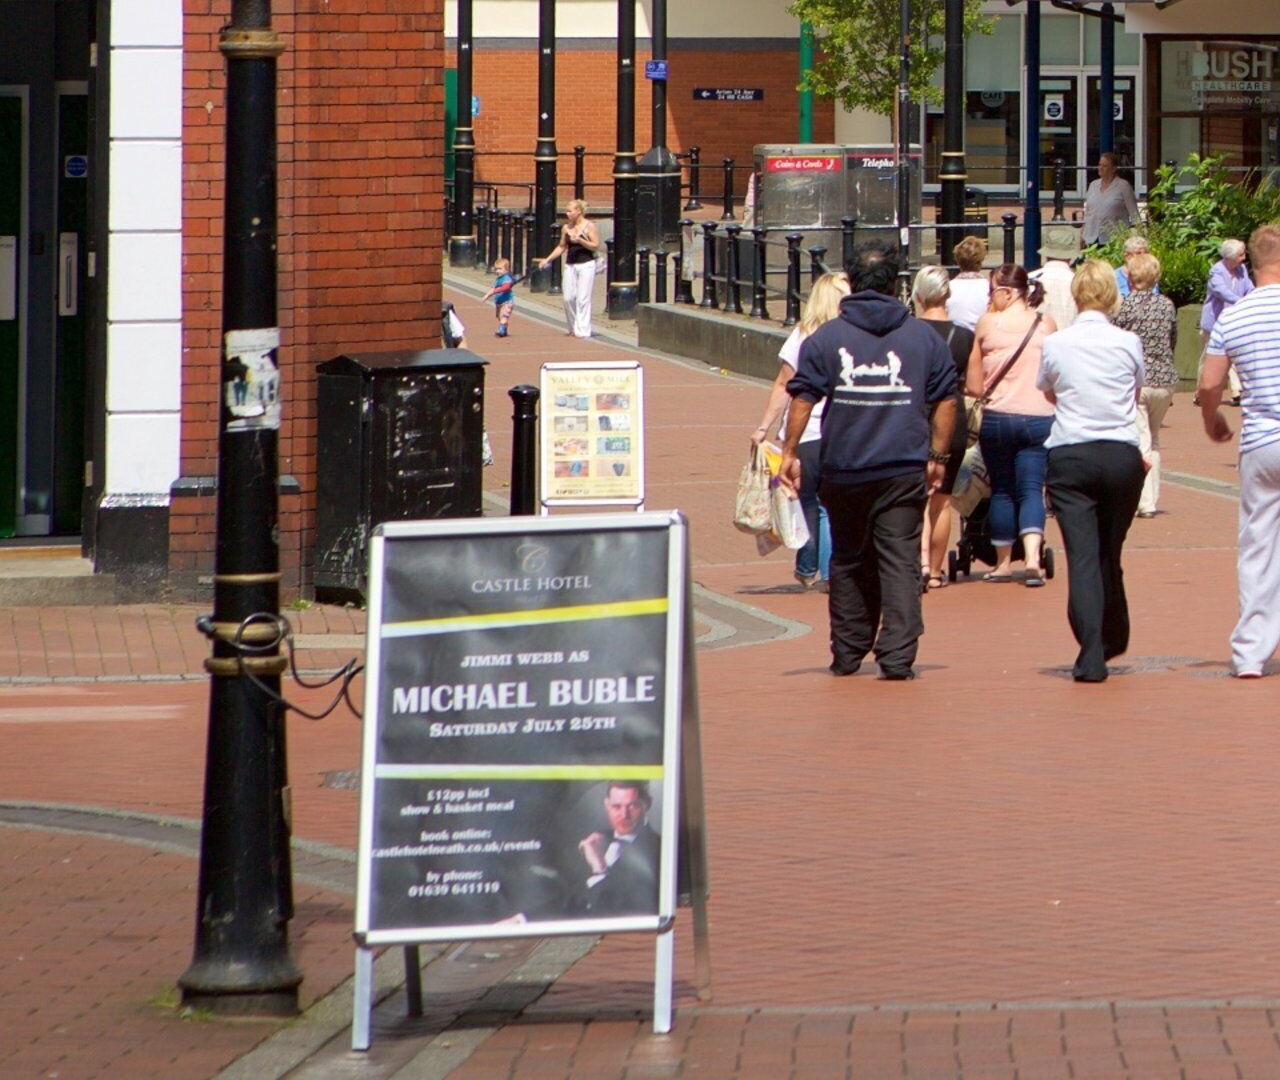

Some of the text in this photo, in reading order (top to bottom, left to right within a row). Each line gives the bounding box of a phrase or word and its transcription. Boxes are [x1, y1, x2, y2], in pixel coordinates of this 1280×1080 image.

[1192, 51, 1272, 78] BUSH
[1195, 81, 1269, 91] HEALTHCARE
[471, 575, 592, 594] CASTLE HOTEL
[460, 650, 590, 668] JIMMI WEBB AS
[392, 675, 657, 715] MICHAEL BUBLE
[429, 721, 519, 739] SATURDAY
[522, 717, 567, 735] JULY
[426, 787, 491, 803] £12pp incl
[400, 799, 515, 817] show & basket meal
[420, 828, 492, 843] book online:
[426, 870, 484, 884] by phone:
[408, 884, 449, 898] 01639
